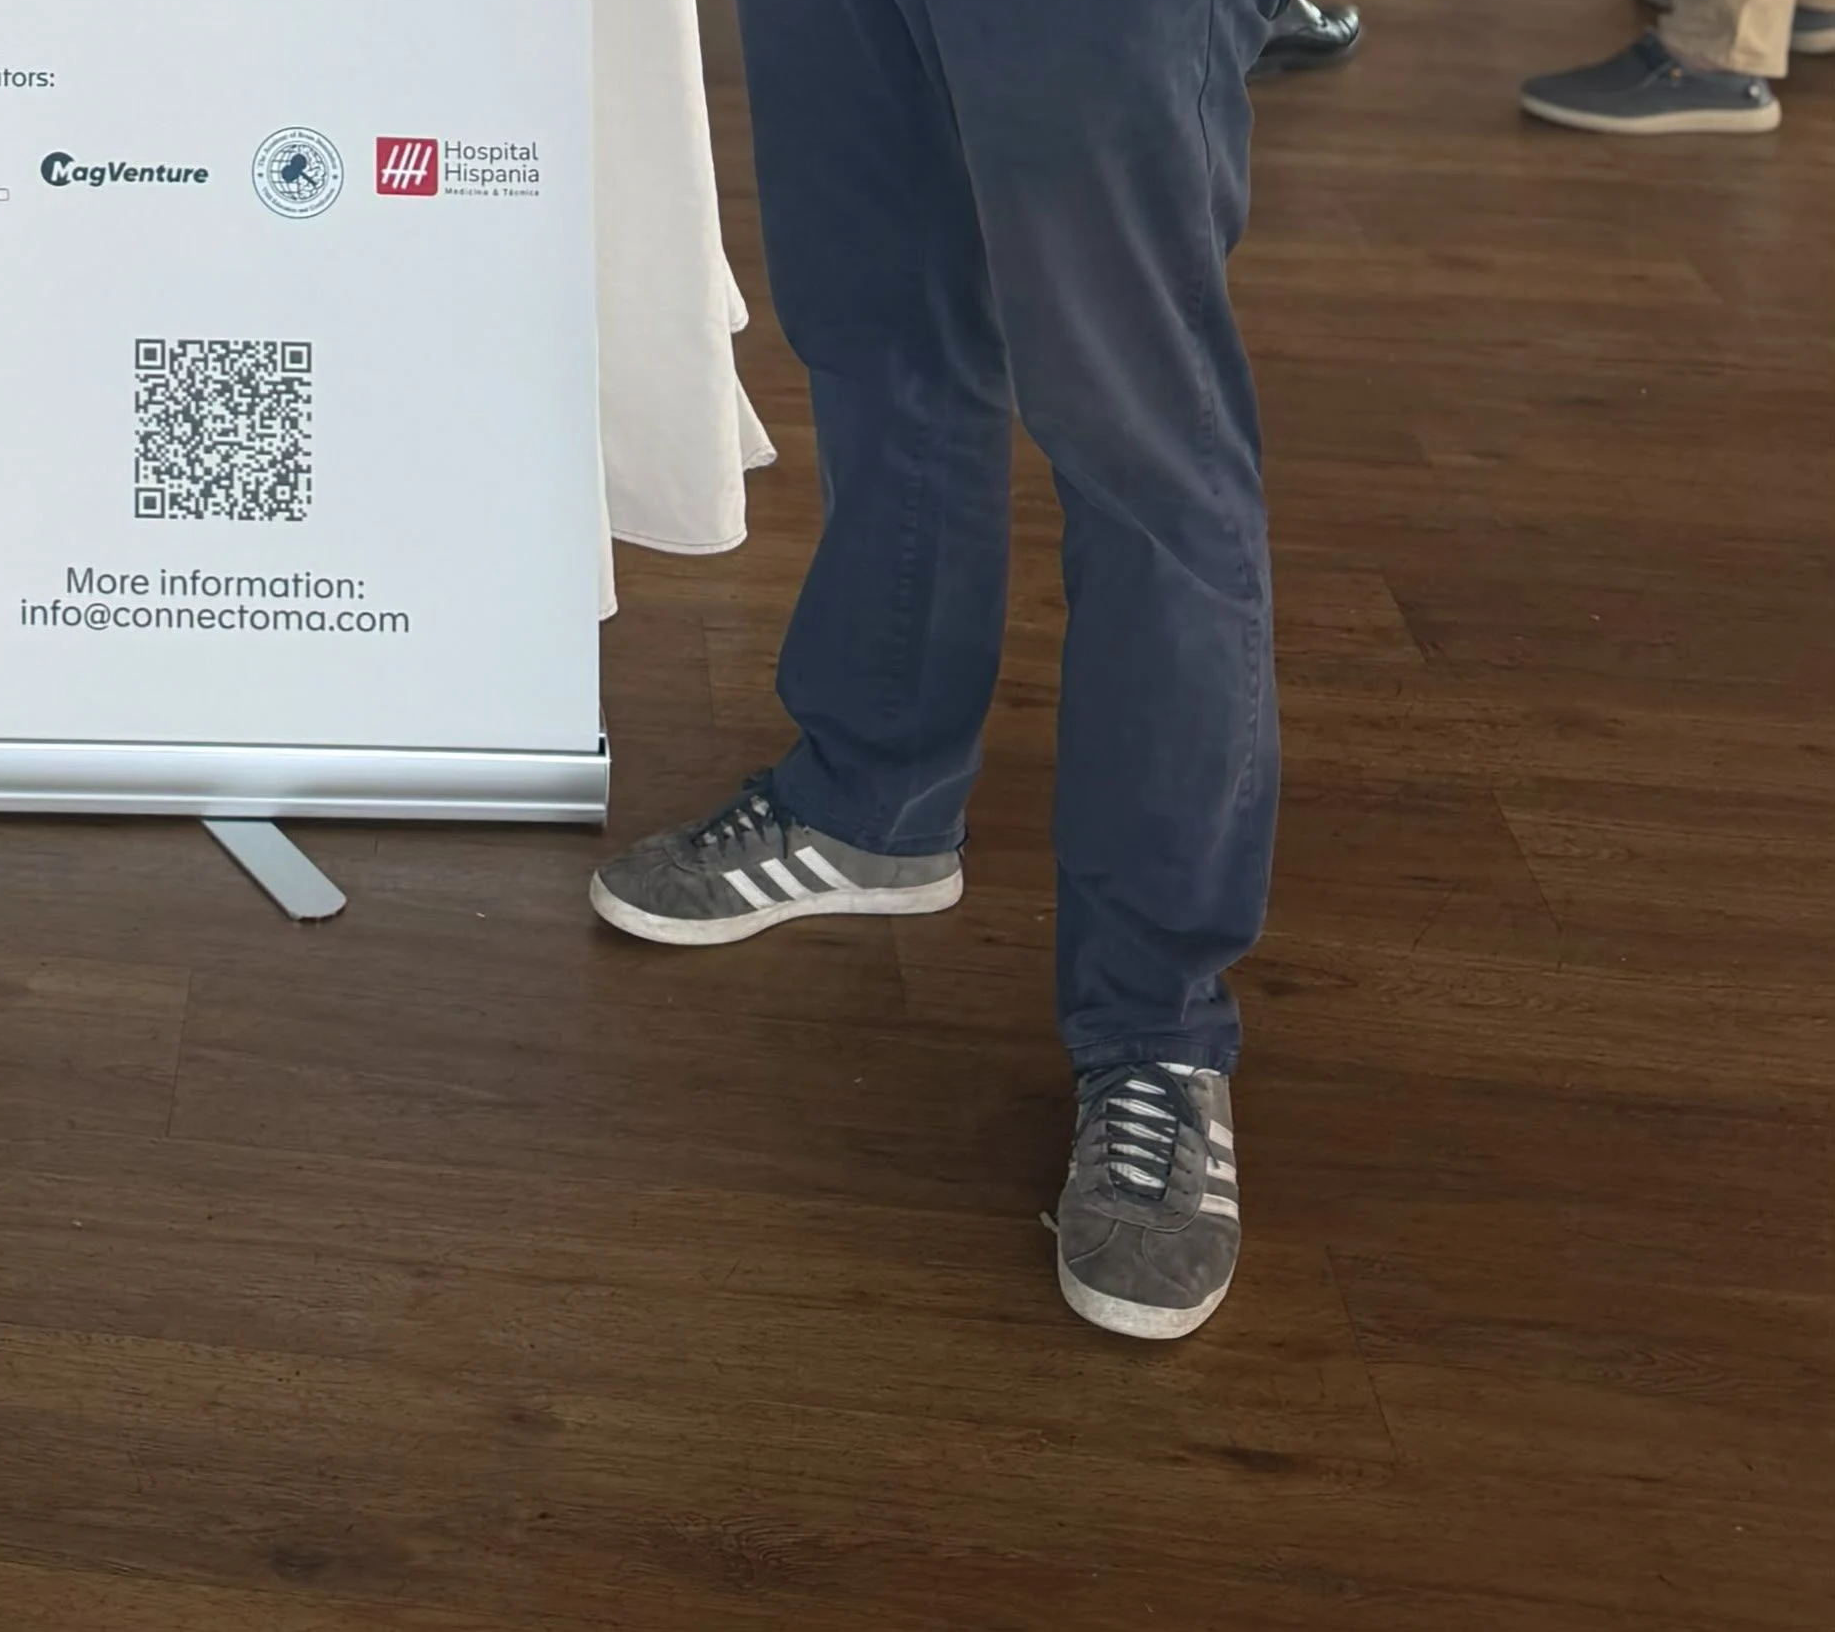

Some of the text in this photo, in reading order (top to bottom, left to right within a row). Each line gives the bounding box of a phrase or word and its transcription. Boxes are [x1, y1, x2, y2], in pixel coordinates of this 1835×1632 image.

[40, 150, 209, 187] MagVenture
[444, 140, 539, 165] Hospital
[444, 163, 540, 186] Hispania
[66, 566, 365, 600] More information:
[19, 598, 410, 635] info@connectoma.com
